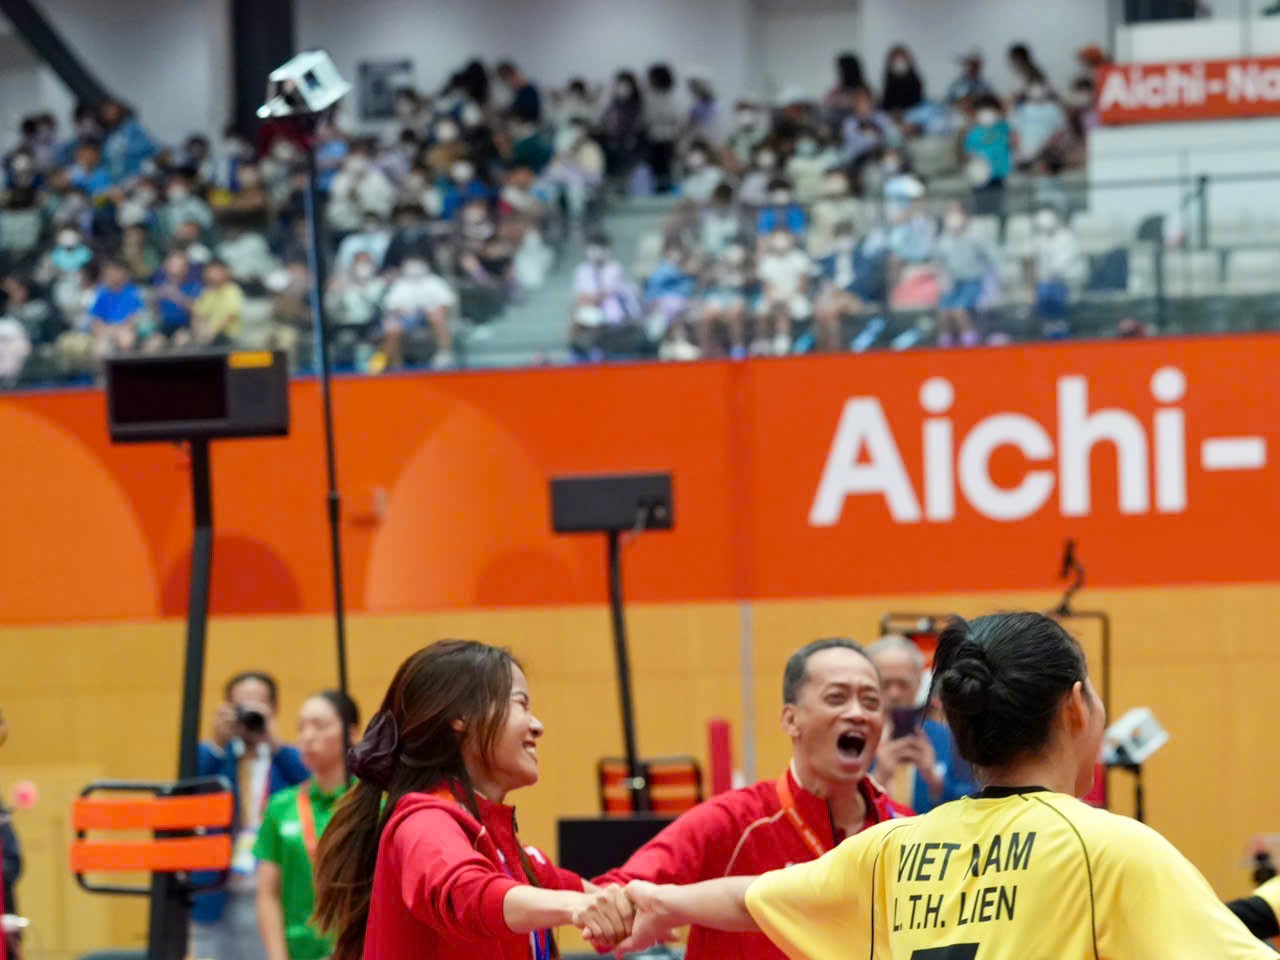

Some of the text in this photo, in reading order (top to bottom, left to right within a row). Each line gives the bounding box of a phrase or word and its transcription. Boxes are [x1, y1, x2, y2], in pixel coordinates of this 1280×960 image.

[897, 832, 1036, 882] VIET NAM
[957, 885, 1017, 926] LIEN
